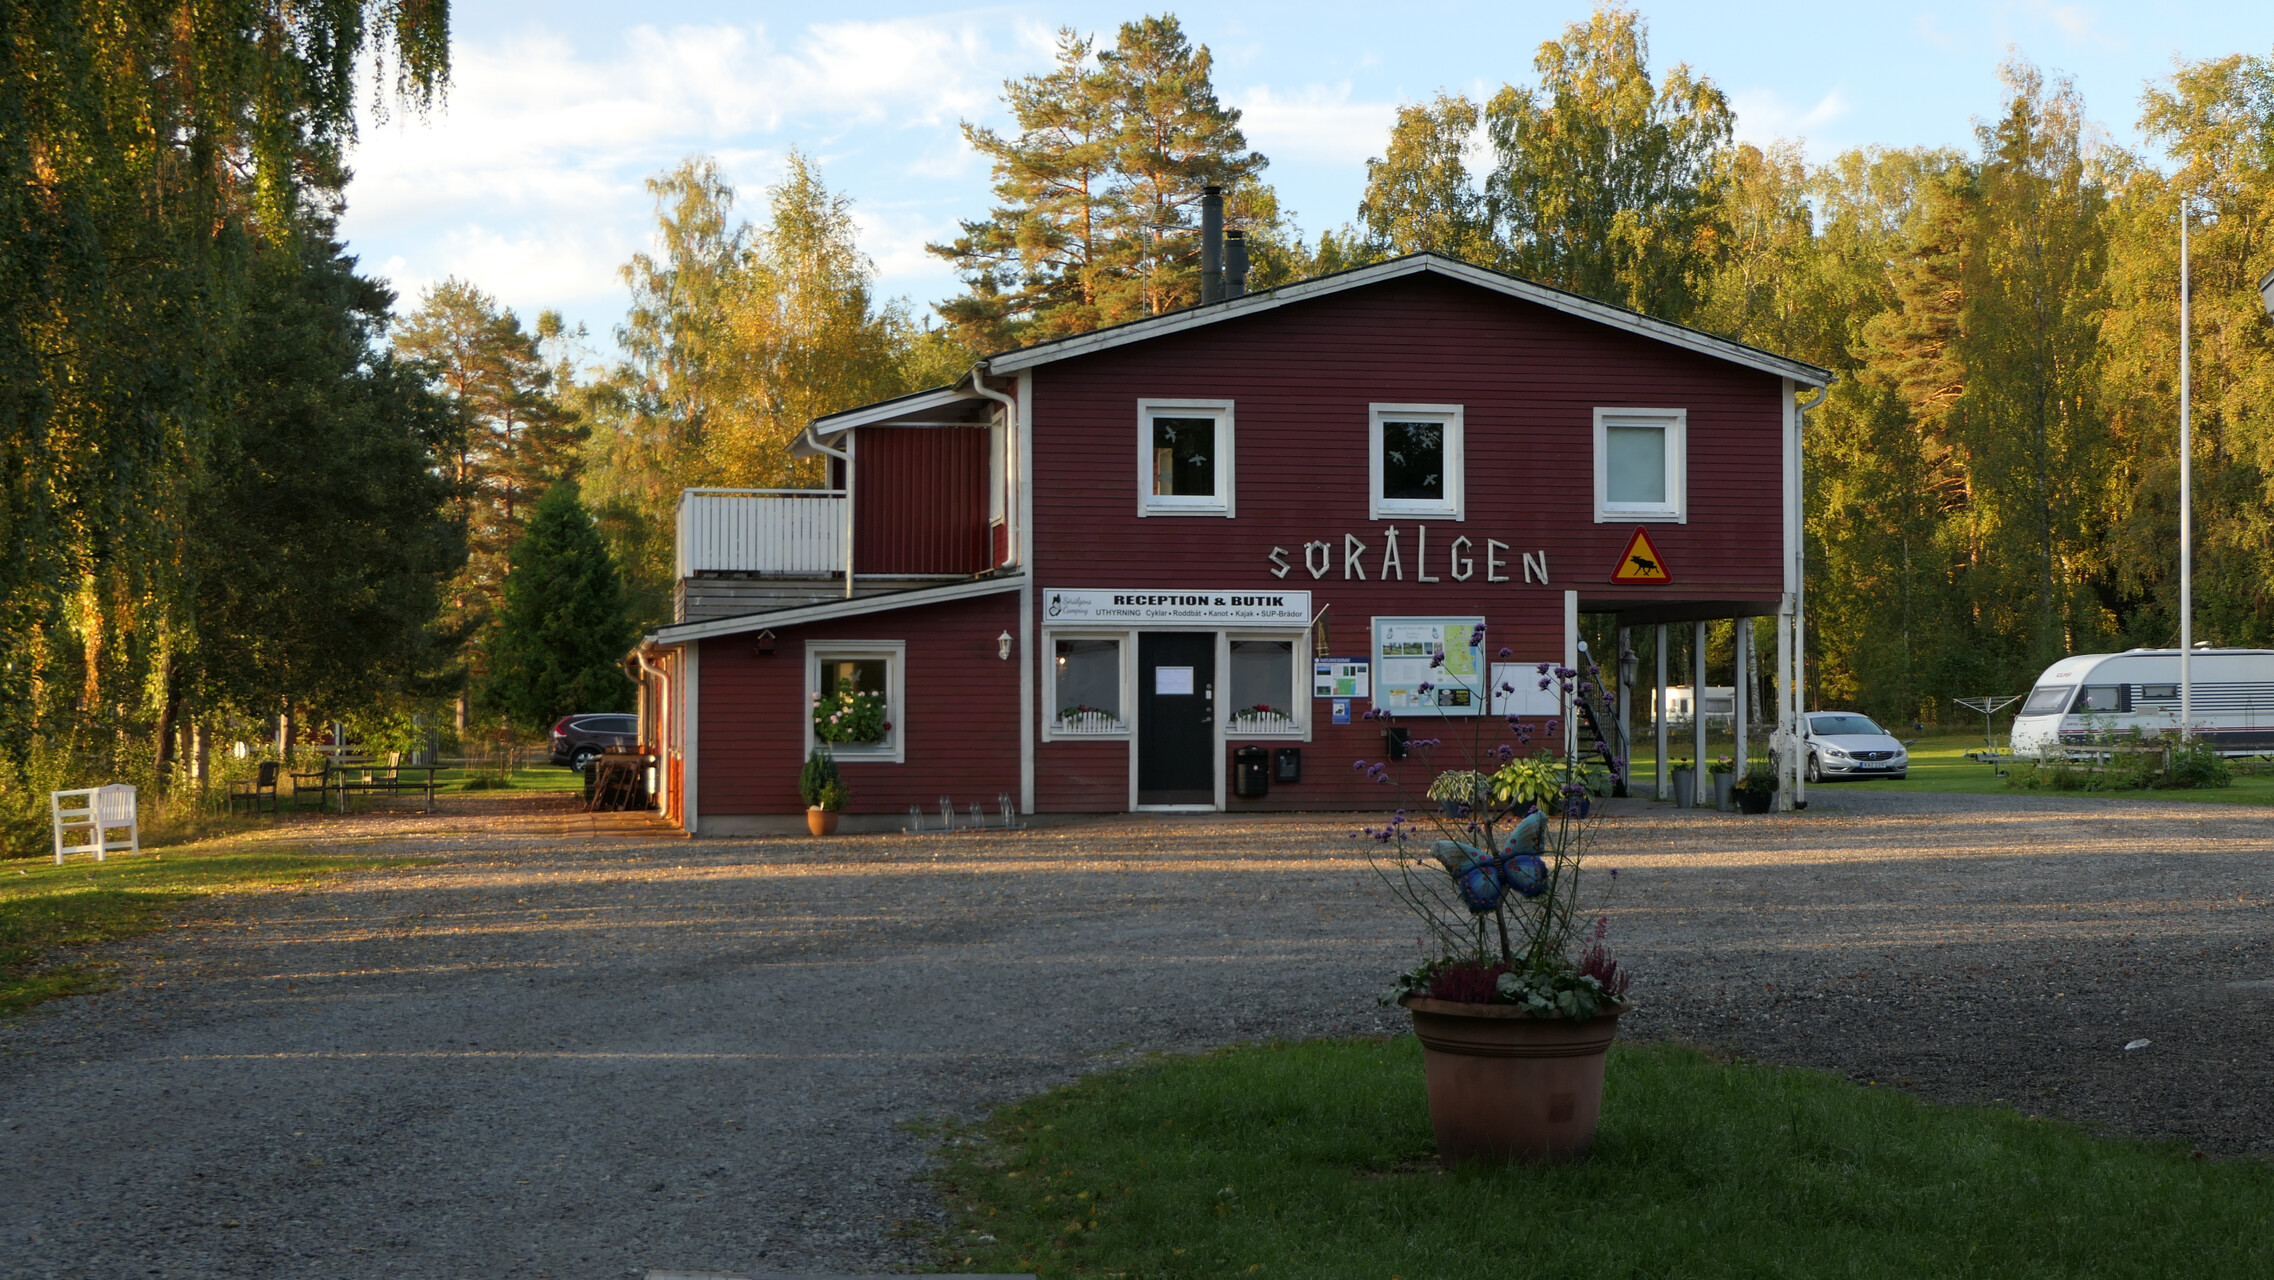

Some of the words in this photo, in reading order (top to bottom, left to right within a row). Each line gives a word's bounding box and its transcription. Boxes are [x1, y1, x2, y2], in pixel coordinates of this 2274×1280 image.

[1113, 595, 1209, 607] RECEPTION
[1214, 597, 1227, 607] &
[1231, 596, 1284, 607] BUTIK
[1095, 609, 1141, 617] UTHYRNING
[1145, 609, 1168, 619] Cyklar
[1172, 609, 1202, 617] Roddbåt
[1235, 610, 1254, 619] Kajak
[1261, 610, 1303, 618] SUP-Brädor
